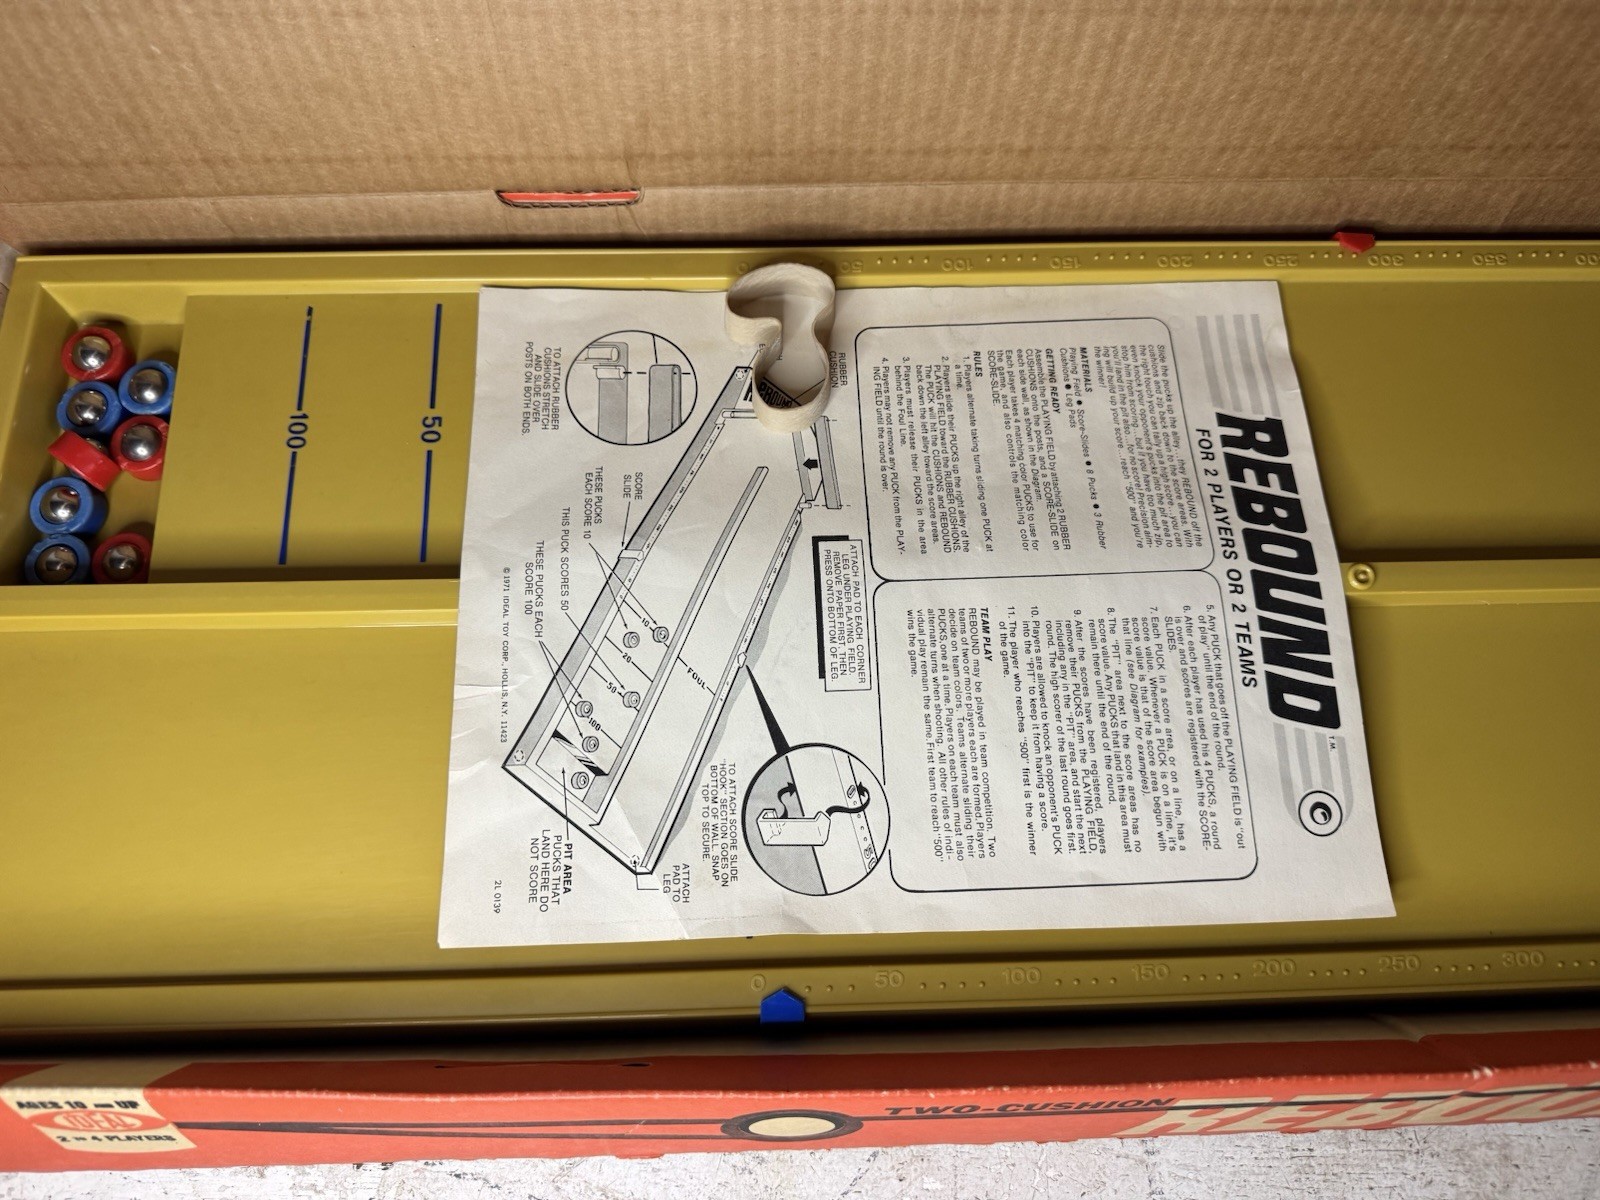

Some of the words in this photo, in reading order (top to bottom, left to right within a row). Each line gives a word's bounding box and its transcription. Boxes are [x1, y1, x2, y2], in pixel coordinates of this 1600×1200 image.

[1050, 255, 1082, 270] 150
[1157, 254, 1194, 269] 200
[1263, 253, 1298, 267] 250
[1367, 254, 1404, 268] 300
[1472, 253, 1507, 267] 350
[1575, 253, 1600, 267] 00
[524, 341, 534, 369] POSTS
[534, 354, 543, 372] AND
[553, 347, 562, 359] TO
[973, 350, 983, 378] RULES
[524, 370, 533, 384] ON
[542, 347, 553, 390] CUSHIONS
[552, 360, 562, 394] ATTACH
[828, 350, 839, 388] CUSHION
[838, 352, 848, 386] RUBBER
[1045, 348, 1057, 384] GETTING
[1079, 346, 1093, 393] MATERIALS
[523, 385, 533, 409] BOTH
[532, 374, 543, 398] SLIDE
[531, 399, 541, 423] OVER
[541, 391, 551, 430] STRETCH
[1050, 386, 1061, 414] READY
[521, 411, 531, 436] ENDS.
[550, 395, 560, 431] RUBBER
[286, 413, 309, 450] 100
[420, 415, 443, 444] 50
[1195, 428, 1216, 461] FOR
[584, 472, 594, 495] EACH
[594, 466, 604, 493] THESE
[1203, 468, 1219, 477] 2
[622, 474, 632, 499] SLIDE
[634, 471, 644, 500] SCORE
[561, 506, 571, 527] THIS
[583, 497, 593, 527] SCORE
[593, 495, 603, 525] PUCKS
[1207, 483, 1238, 560] PLAYERS
[560, 529, 570, 554] PUCK
[583, 530, 592, 540] 10
[535, 540, 545, 571] THESE
[823, 549, 833, 576] PRESS
[841, 553, 851, 571] LEG
[849, 544, 860, 578] ATTACH
[524, 561, 534, 596] SCORE
[560, 556, 570, 597] SCORES
[832, 551, 843, 586] REMOVE
[1215, 412, 1342, 730] REBOUND
[534, 574, 544, 608] PUCKS
[825, 578, 835, 604] ONTO
[842, 573, 852, 603] UNDER
[852, 580, 861, 599] PAD
[1226, 568, 1244, 595] OR
[502, 595, 510, 619] IDEAL
[524, 599, 534, 615] 100
[560, 599, 570, 611] 50
[835, 589, 845, 619] PAPER
[853, 600, 862, 613] TO
[1007, 605, 1016, 619] 11.
[1231, 603, 1247, 613] 2
[502, 621, 510, 637] TOY
[534, 610, 544, 638] EACH
[641, 617, 650, 628] 10
[827, 606, 838, 644] BOTTOM
[845, 605, 855, 644] PLAYING
[854, 615, 864, 640] EACH
[980, 607, 991, 634] TEAM
[998, 621, 1008, 630] of
[1008, 620, 1018, 638] The
[837, 621, 846, 649] FIRST,
[999, 632, 1008, 648] the
[501, 640, 509, 667] CORP.,
[622, 652, 632, 664] 20
[829, 646, 838, 659] OF
[847, 647, 857, 676] FIELD.
[982, 636, 993, 662] PLAY
[1008, 641, 1019, 669] player
[1234, 621, 1258, 688] TEAMS
[830, 661, 839, 682] LEG.
[838, 651, 848, 676] THEN
[856, 644, 866, 684] CORNER
[999, 650, 1010, 678] game.
[500, 668, 509, 700] HOLLIS,
[606, 681, 618, 694] 50
[687, 667, 706, 690] FOUL
[1013, 672, 1023, 693] who
[501, 701, 509, 717] N.Y.
[1015, 695, 1026, 733] reaches
[500, 720, 508, 743] 11423
[588, 717, 602, 732] 100
[728, 762, 736, 776] TO
[1021, 767, 1032, 787] first
[701, 783, 710, 803] TOP
[709, 764, 719, 804] BOTTOM
[1023, 790, 1033, 799] is
[728, 778, 737, 816] ATTACH
[701, 805, 710, 819] TO
[710, 807, 719, 820] OF
[719, 798, 728, 839] SECTION
[1024, 802, 1034, 818] the
[541, 829, 551, 859] LAND
[701, 821, 711, 862] SECURE.
[711, 822, 719, 852] WALL.
[729, 818, 738, 851] SCORE
[1026, 821, 1037, 856] winner
[529, 837, 540, 861] NOT
[552, 834, 563, 873] PUCKS
[564, 843, 573, 860] PIT
[720, 842, 729, 870] GOES
[540, 862, 551, 892] HERE
[562, 864, 573, 895] AREA
[672, 865, 681, 886] PAD
[711, 854, 720, 881] SNAP
[720, 872, 730, 887] ON
[729, 854, 739, 882] SLIDE
[494, 879, 503, 890] 2L
[528, 864, 539, 904] SCORE
[551, 875, 561, 906] THAT
[662, 873, 672, 894] LEG
[672, 888, 681, 903] TO
[681, 862, 691, 904] ATTACH
[493, 892, 502, 914] 0139
[539, 895, 550, 913] DO
[1252, 958, 1297, 978] 200
[1378, 954, 1421, 974] 250
[1502, 950, 1545, 969] 300
[750, 973, 767, 992] 0
[873, 969, 905, 989] 50
[1002, 966, 1042, 986] 100
[1131, 963, 1171, 982] 150
[16, 1100, 63, 1109] AGES
[64, 1100, 88, 1109] 10
[113, 1100, 141, 1109] UP
[885, 1098, 1176, 1116] TWO-CUSHION
[1112, 1082, 1600, 1138] REBOU
[62, 1112, 138, 1130] IDEAL
[56, 1135, 70, 1143] 2
[91, 1135, 103, 1143] 4
[104, 1134, 178, 1143] PLAYERS
